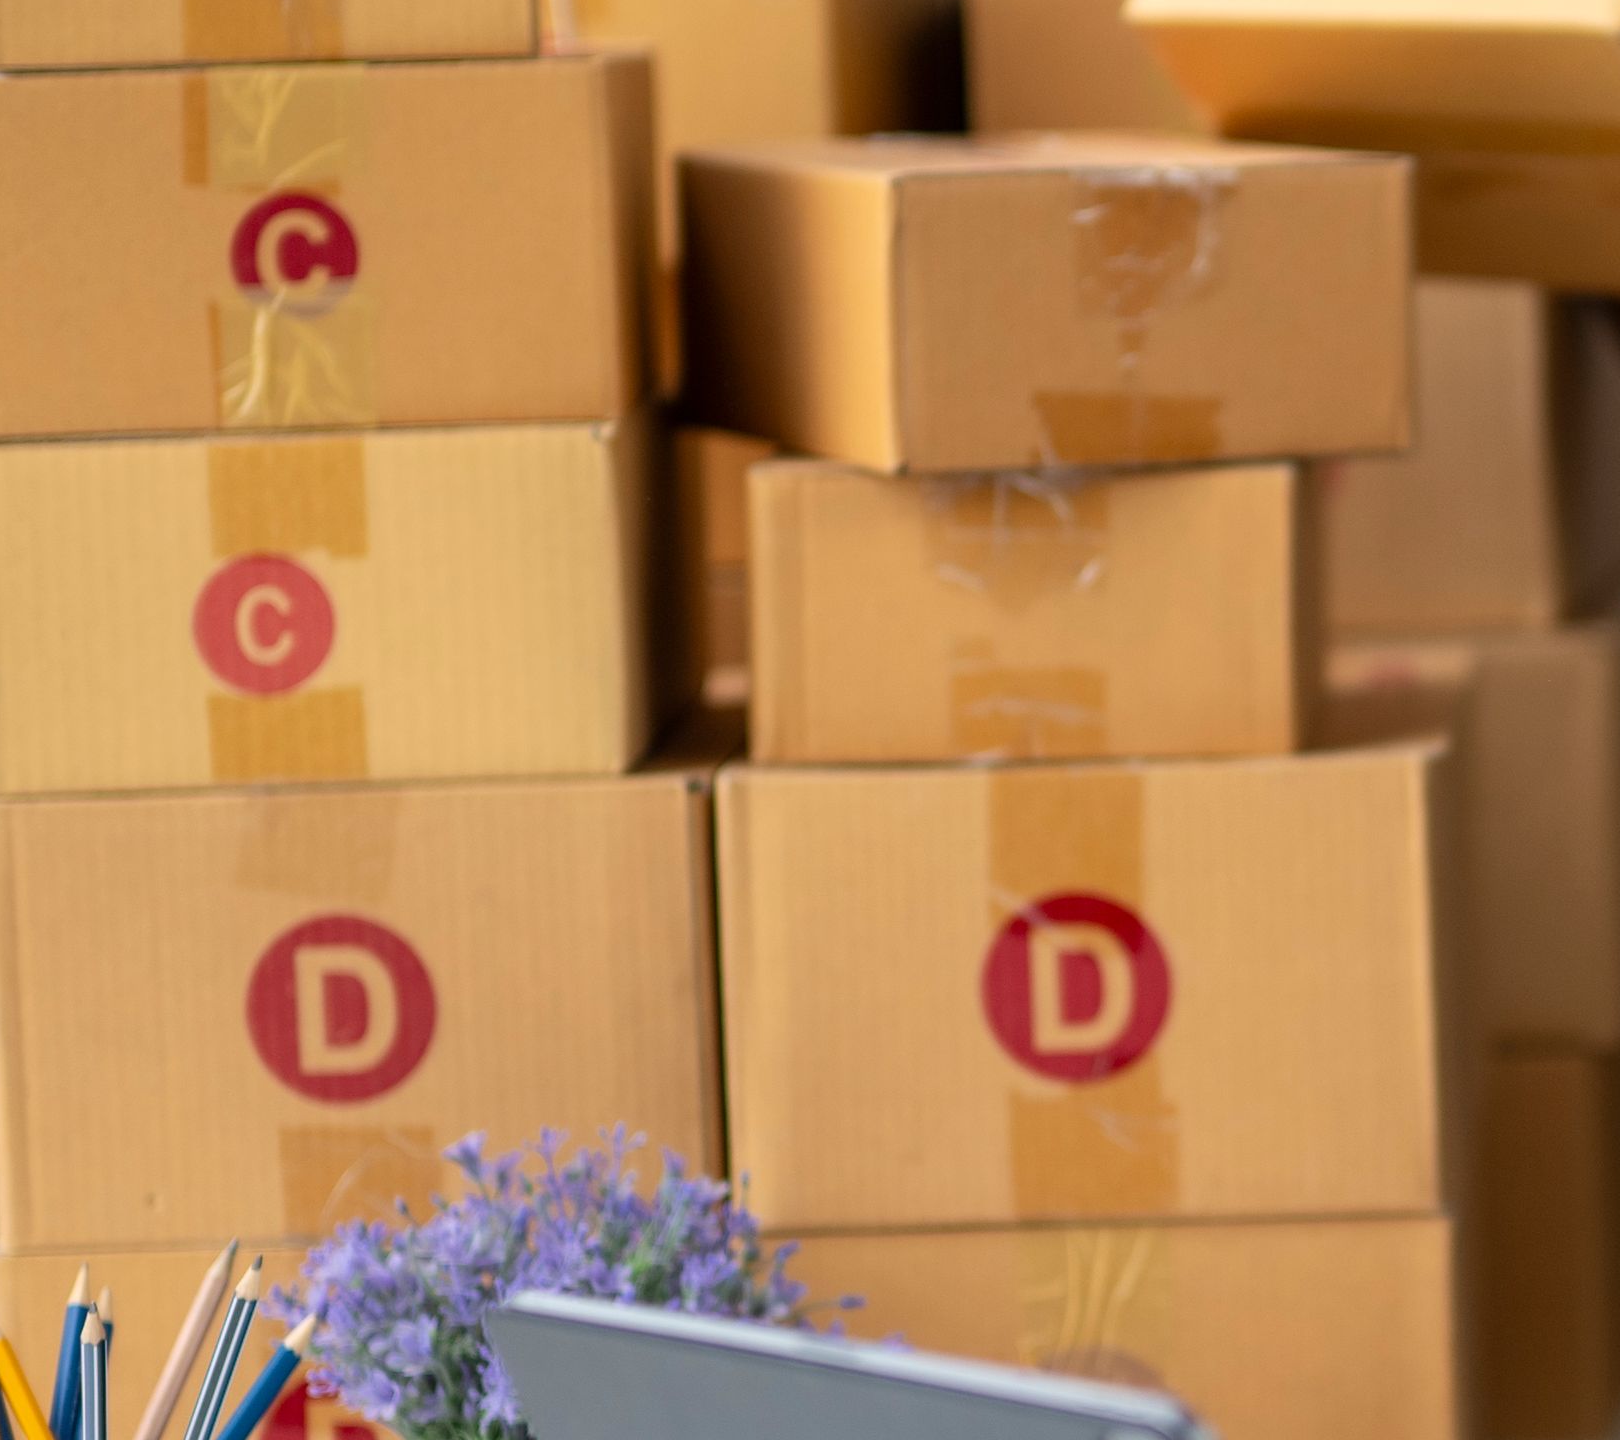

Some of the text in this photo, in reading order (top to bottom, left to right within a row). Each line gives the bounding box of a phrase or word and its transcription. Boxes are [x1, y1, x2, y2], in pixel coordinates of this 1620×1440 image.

[256, 208, 328, 301] C
[235, 583, 296, 667] C
[293, 942, 399, 1075] D
[1026, 922, 1135, 1055] D
